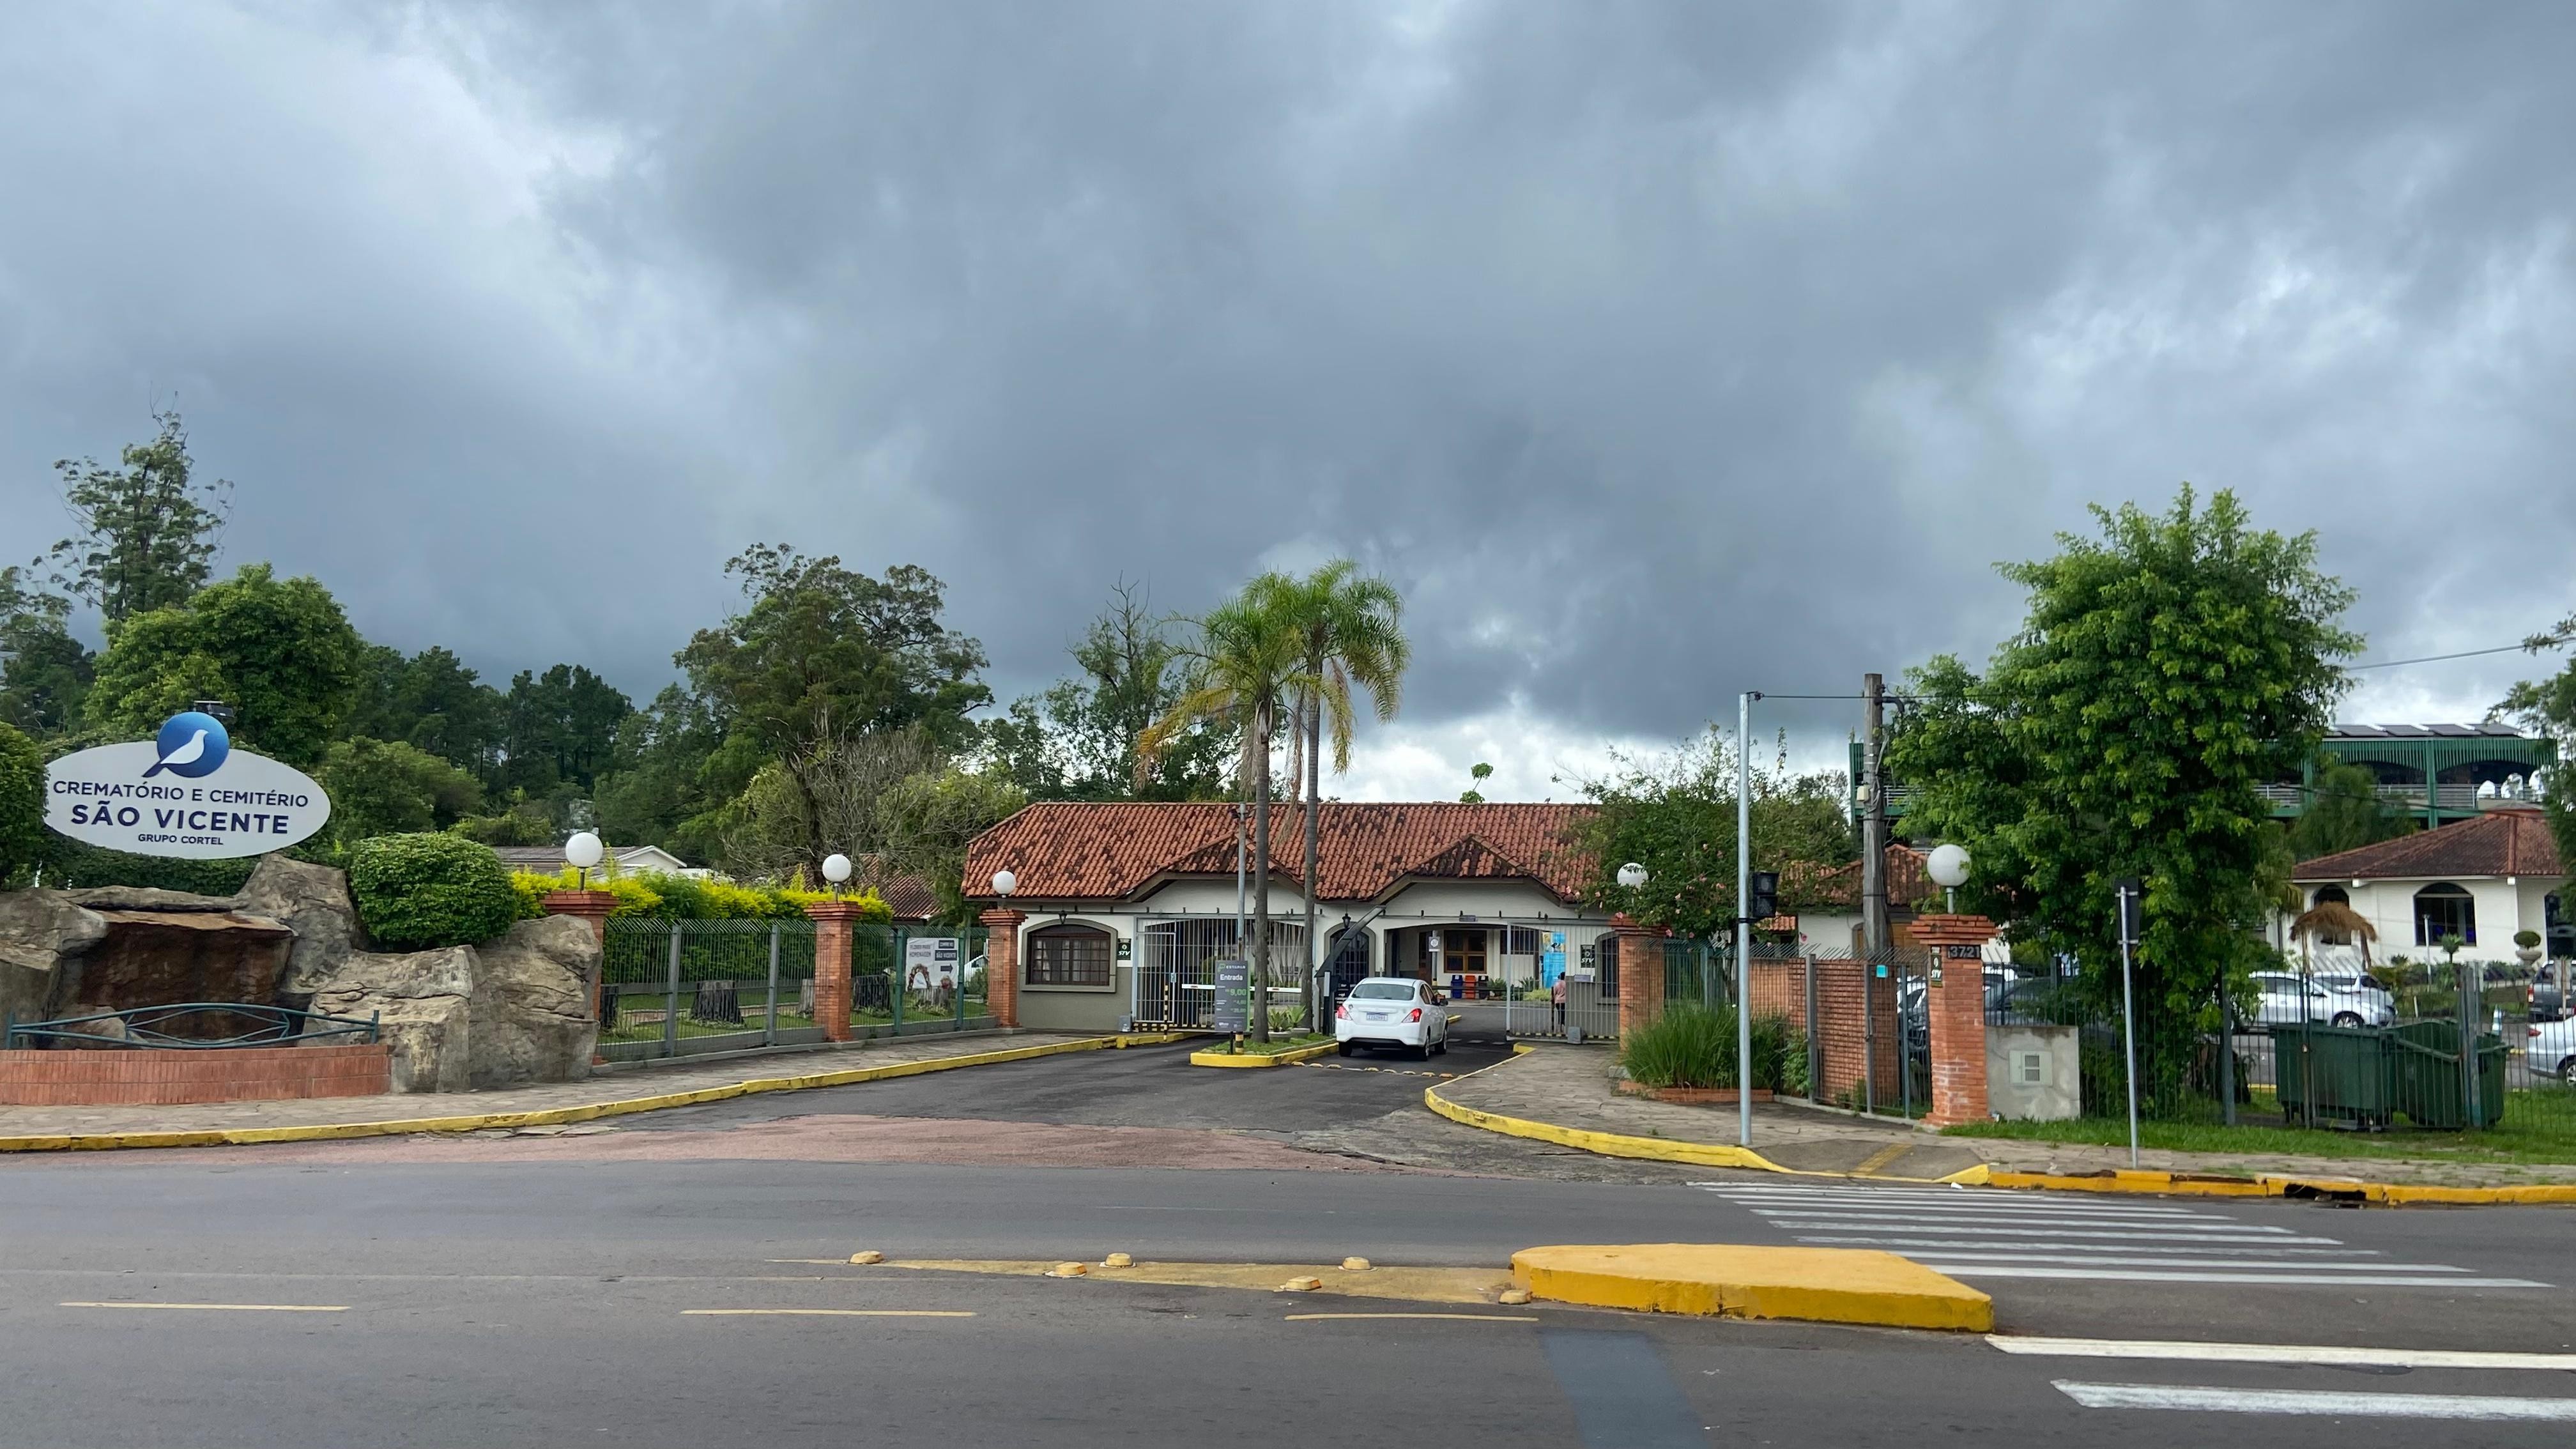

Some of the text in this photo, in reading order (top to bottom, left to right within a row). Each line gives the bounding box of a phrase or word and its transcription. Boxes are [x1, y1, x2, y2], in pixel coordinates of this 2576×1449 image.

[54, 781, 309, 808] CREMATÓRIO E CEMITÉRIO
[71, 801, 289, 834] SÃO VICENTE
[138, 834, 224, 845] GRUPO CORTEL
[1950, 946, 1980, 958] 3721
